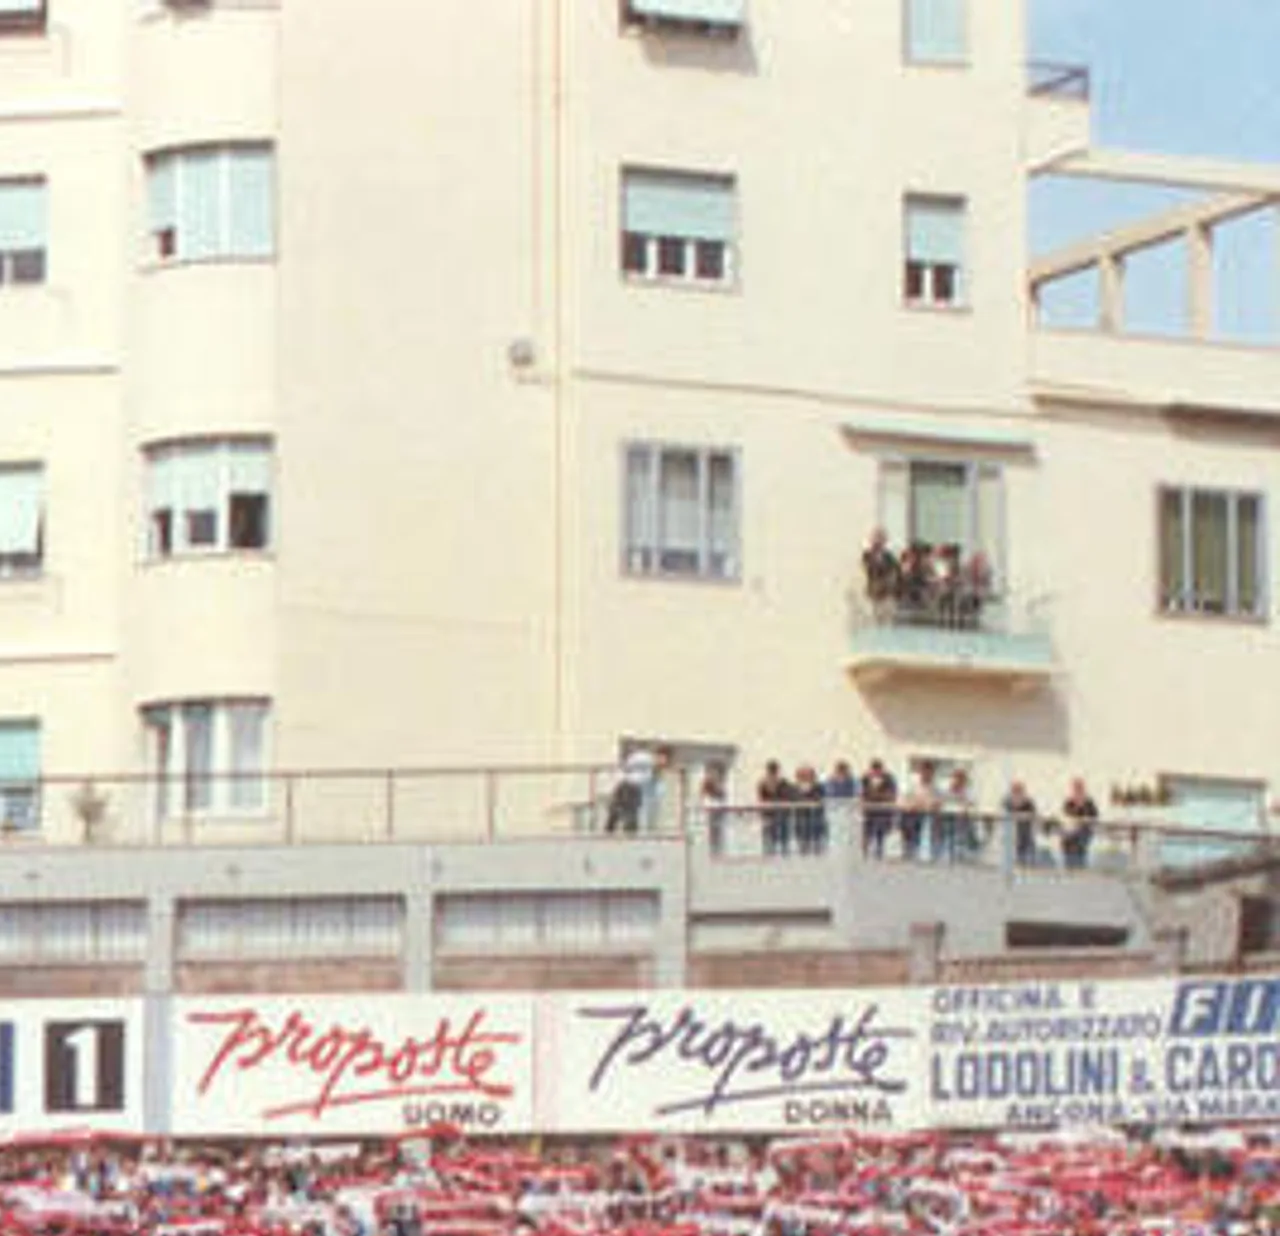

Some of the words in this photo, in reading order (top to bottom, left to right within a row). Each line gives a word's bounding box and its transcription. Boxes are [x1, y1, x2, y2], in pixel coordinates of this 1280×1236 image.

[932, 984, 1063, 1013] OFFICINA
[52, 1021, 115, 1110] 1
[186, 1007, 521, 1118] proposte
[578, 1002, 914, 1116] proposte
[931, 1048, 1120, 1101] LODOLINI
[402, 1102, 502, 1126] UOMO
[783, 1099, 894, 1125] DONNA
[1007, 1101, 1124, 1122] ANCONA
